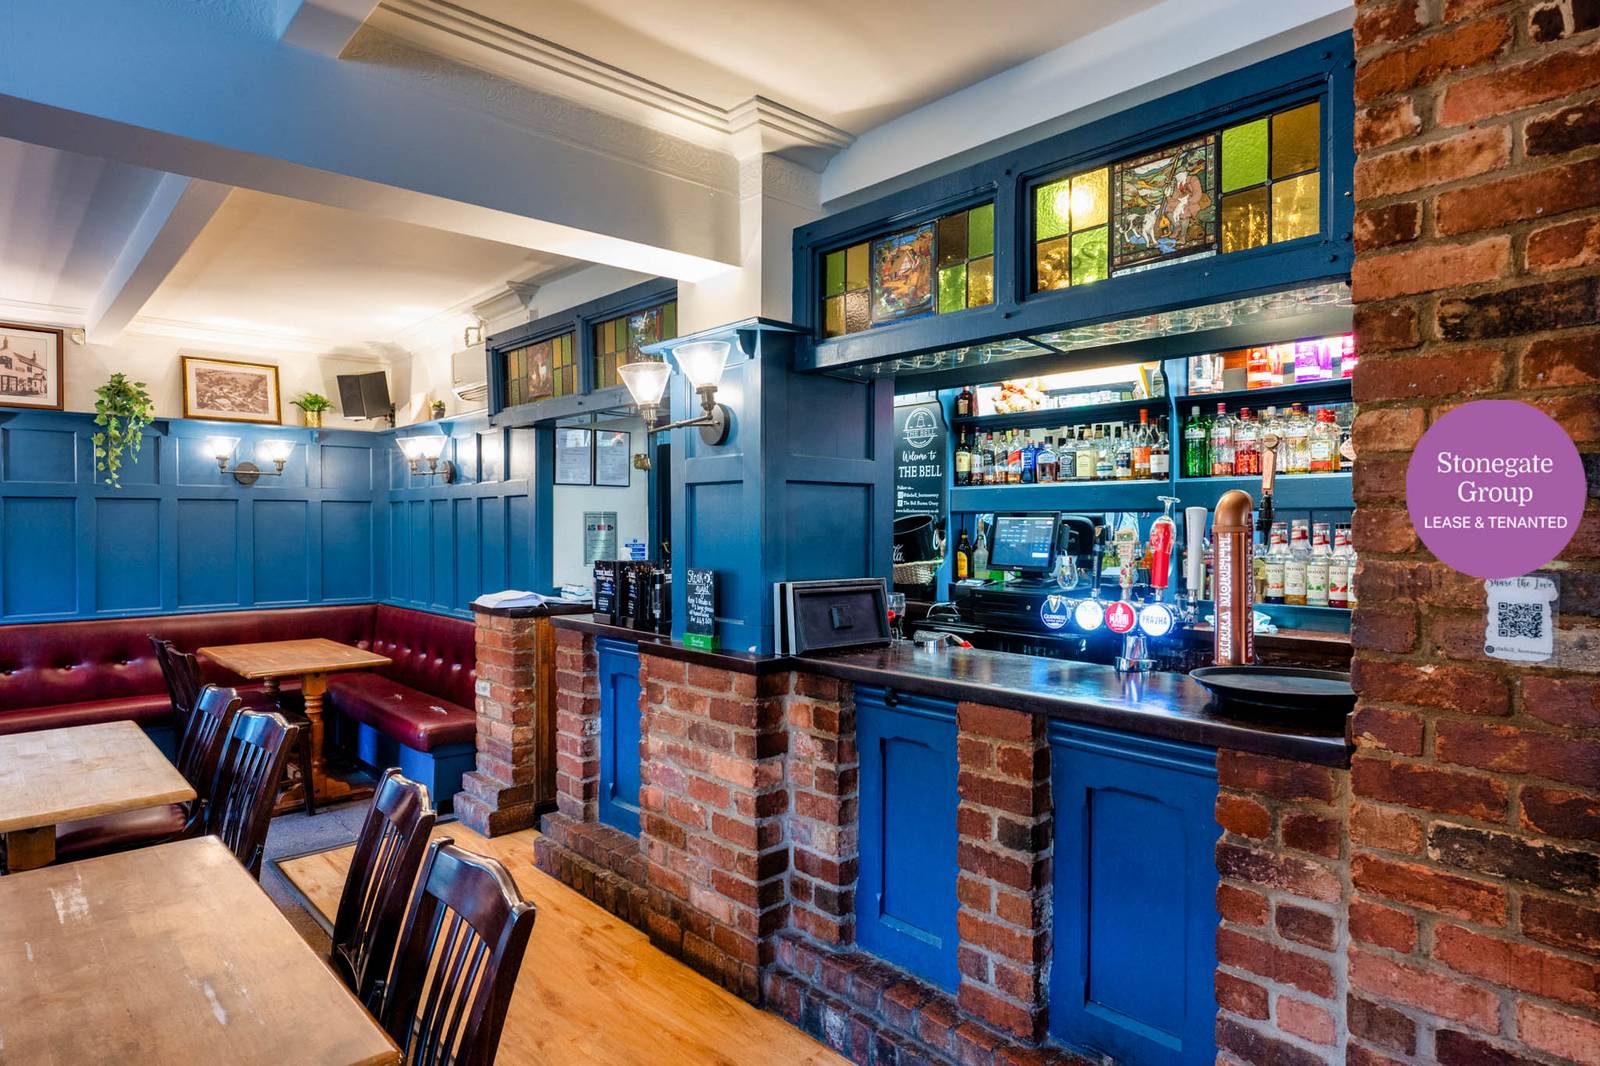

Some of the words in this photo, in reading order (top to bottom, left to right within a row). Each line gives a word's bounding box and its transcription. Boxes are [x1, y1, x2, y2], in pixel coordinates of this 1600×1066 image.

[902, 450, 928, 463] Welcome
[928, 450, 937, 461] to
[898, 465, 918, 478] THE
[919, 464, 943, 478] BELL
[1219, 533, 1231, 607] MORETTI
[1142, 615, 1168, 625] PRAVHA
[1219, 611, 1231, 660] BIRRA
